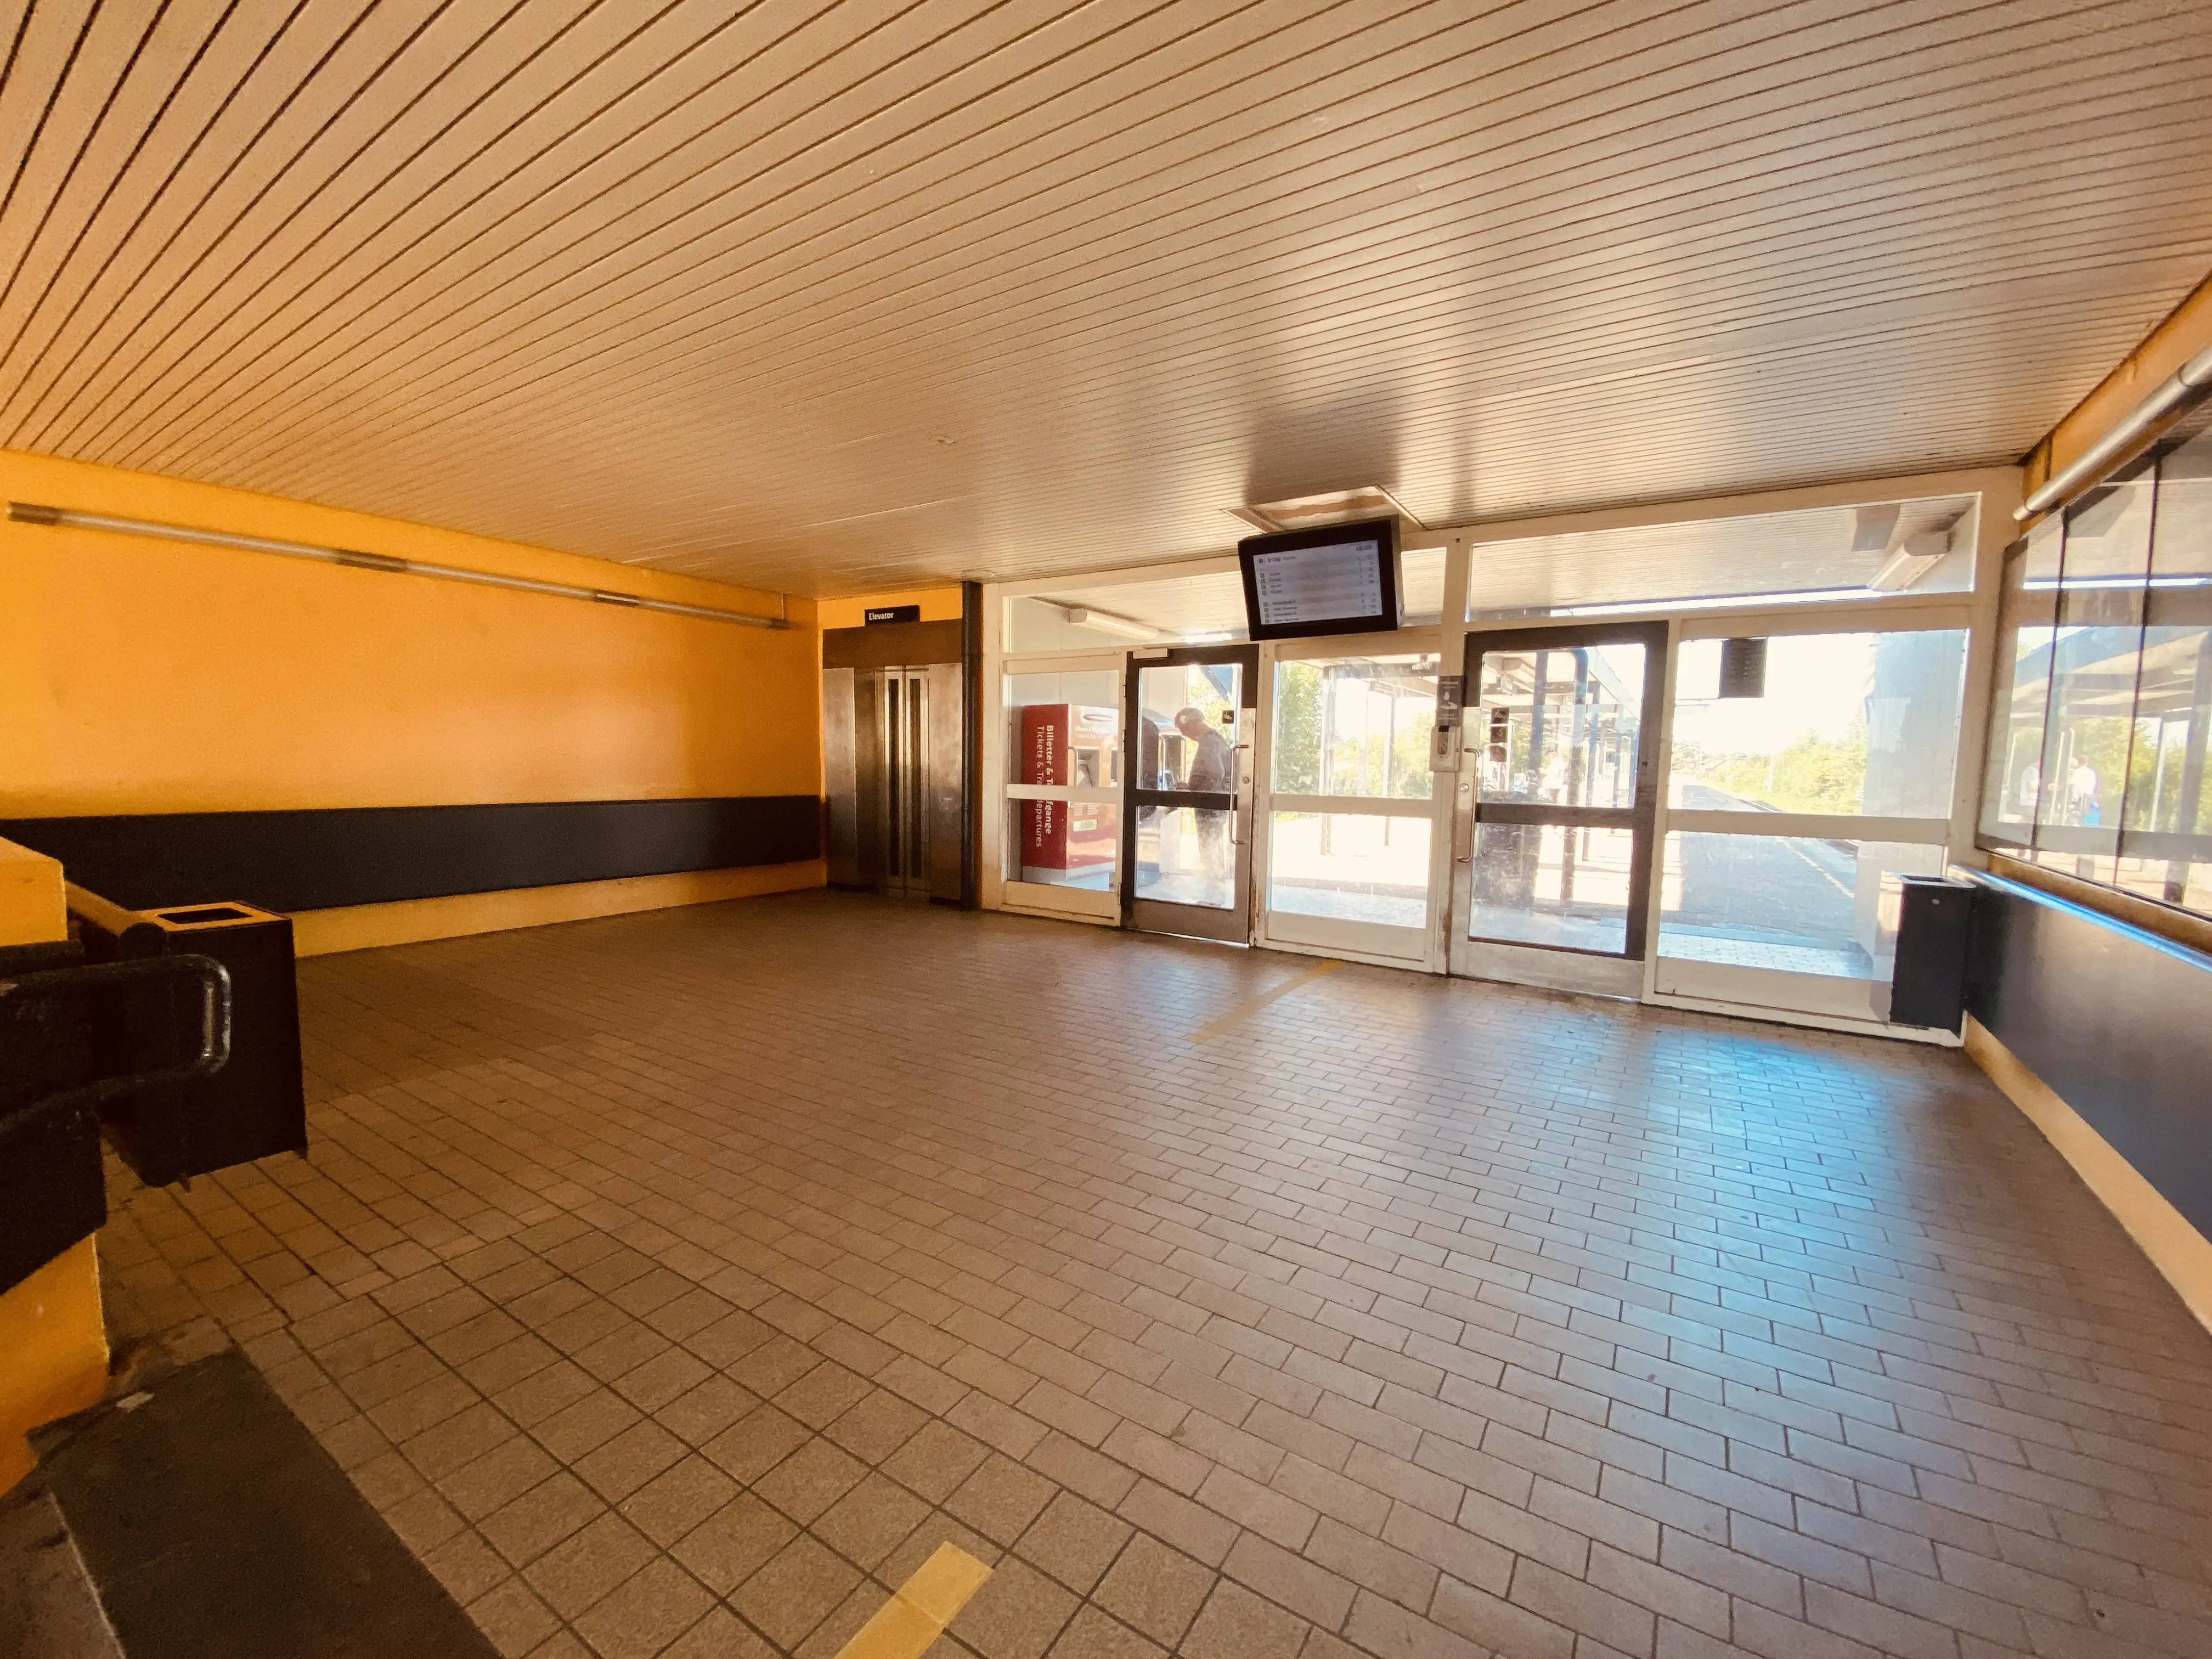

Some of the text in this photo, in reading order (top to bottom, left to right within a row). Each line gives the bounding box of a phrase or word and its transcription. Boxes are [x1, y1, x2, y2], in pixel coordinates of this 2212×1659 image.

[868, 612, 894, 620] Elevator
[1036, 725, 1045, 758] Tickets
[1045, 777, 1053, 834] Tfgange
